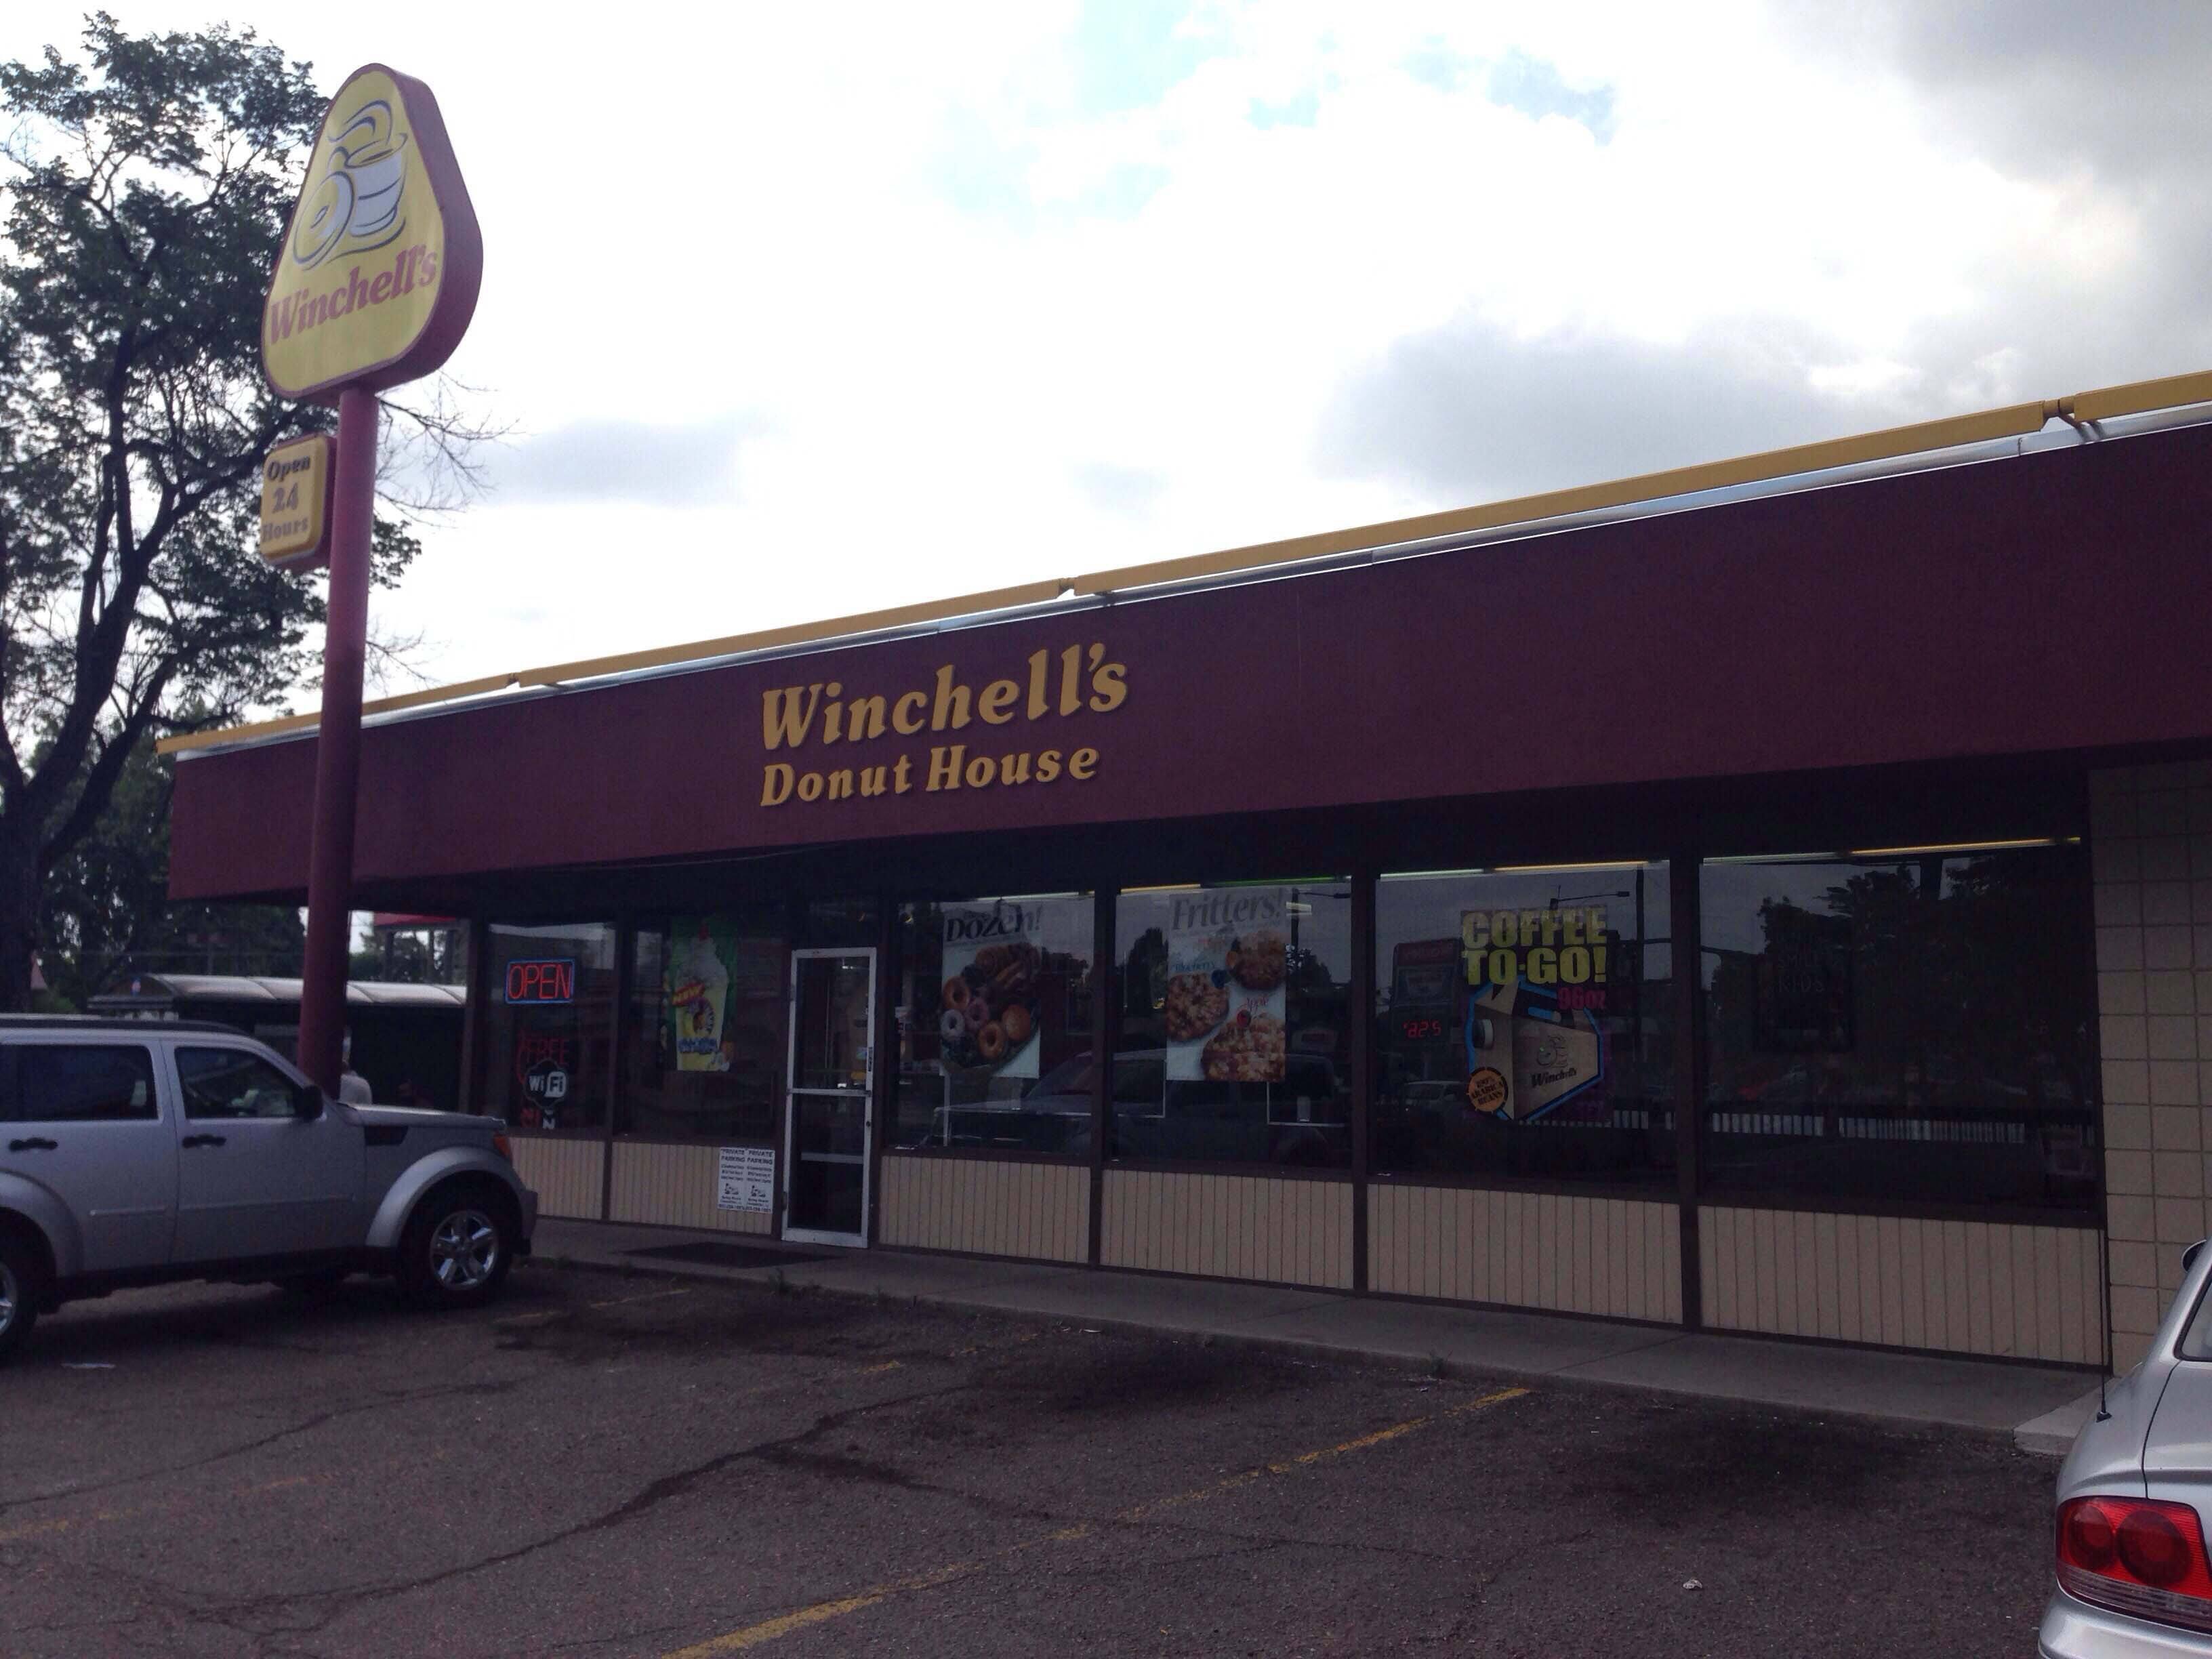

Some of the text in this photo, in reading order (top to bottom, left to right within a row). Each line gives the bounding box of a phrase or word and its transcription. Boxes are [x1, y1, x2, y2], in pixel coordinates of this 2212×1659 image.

[270, 244, 438, 345] Winchell's
[267, 455, 310, 482] Open
[272, 483, 298, 513] 24
[262, 517, 308, 544] Hours
[762, 642, 1128, 750] Winchell's
[760, 744, 1099, 807] Donut House
[1462, 905, 1607, 949] COFFEE
[508, 964, 573, 999] OPEN
